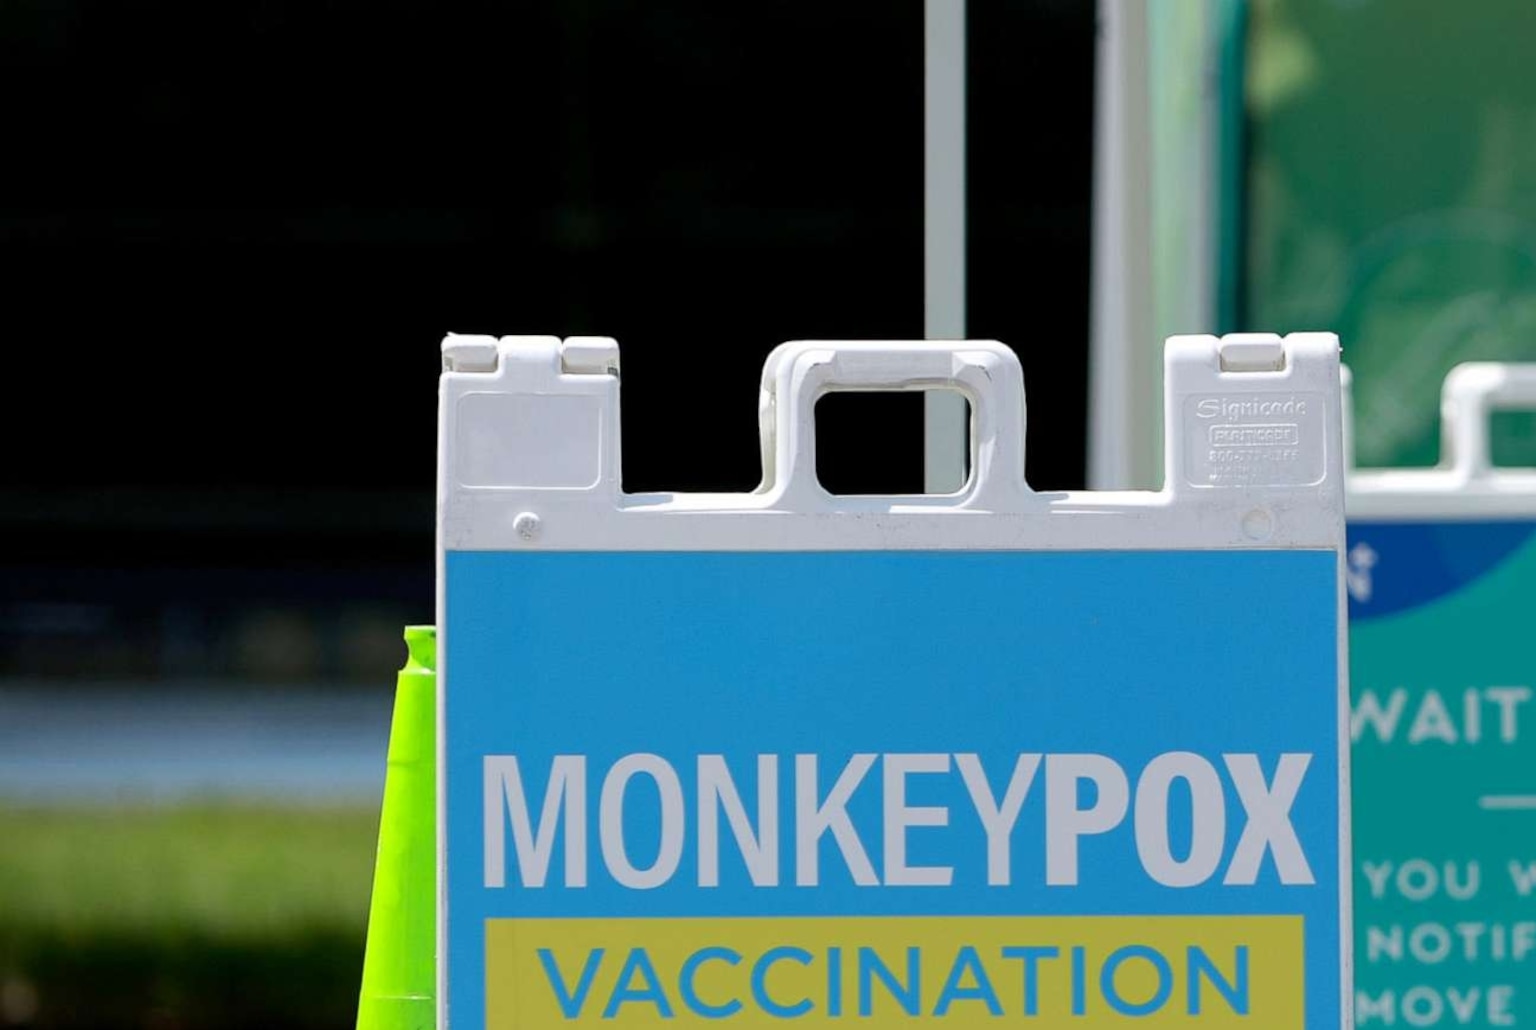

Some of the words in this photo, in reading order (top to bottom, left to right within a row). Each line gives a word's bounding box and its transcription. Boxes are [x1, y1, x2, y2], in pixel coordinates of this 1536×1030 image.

[1196, 396, 1307, 421] Signicade
[1350, 686, 1532, 744] WAIT
[482, 750, 1317, 890] MONKEYPOX
[1362, 858, 1480, 901] YOU
[537, 944, 1250, 1020] VACCINATION
[1354, 985, 1515, 1027] MOVE
